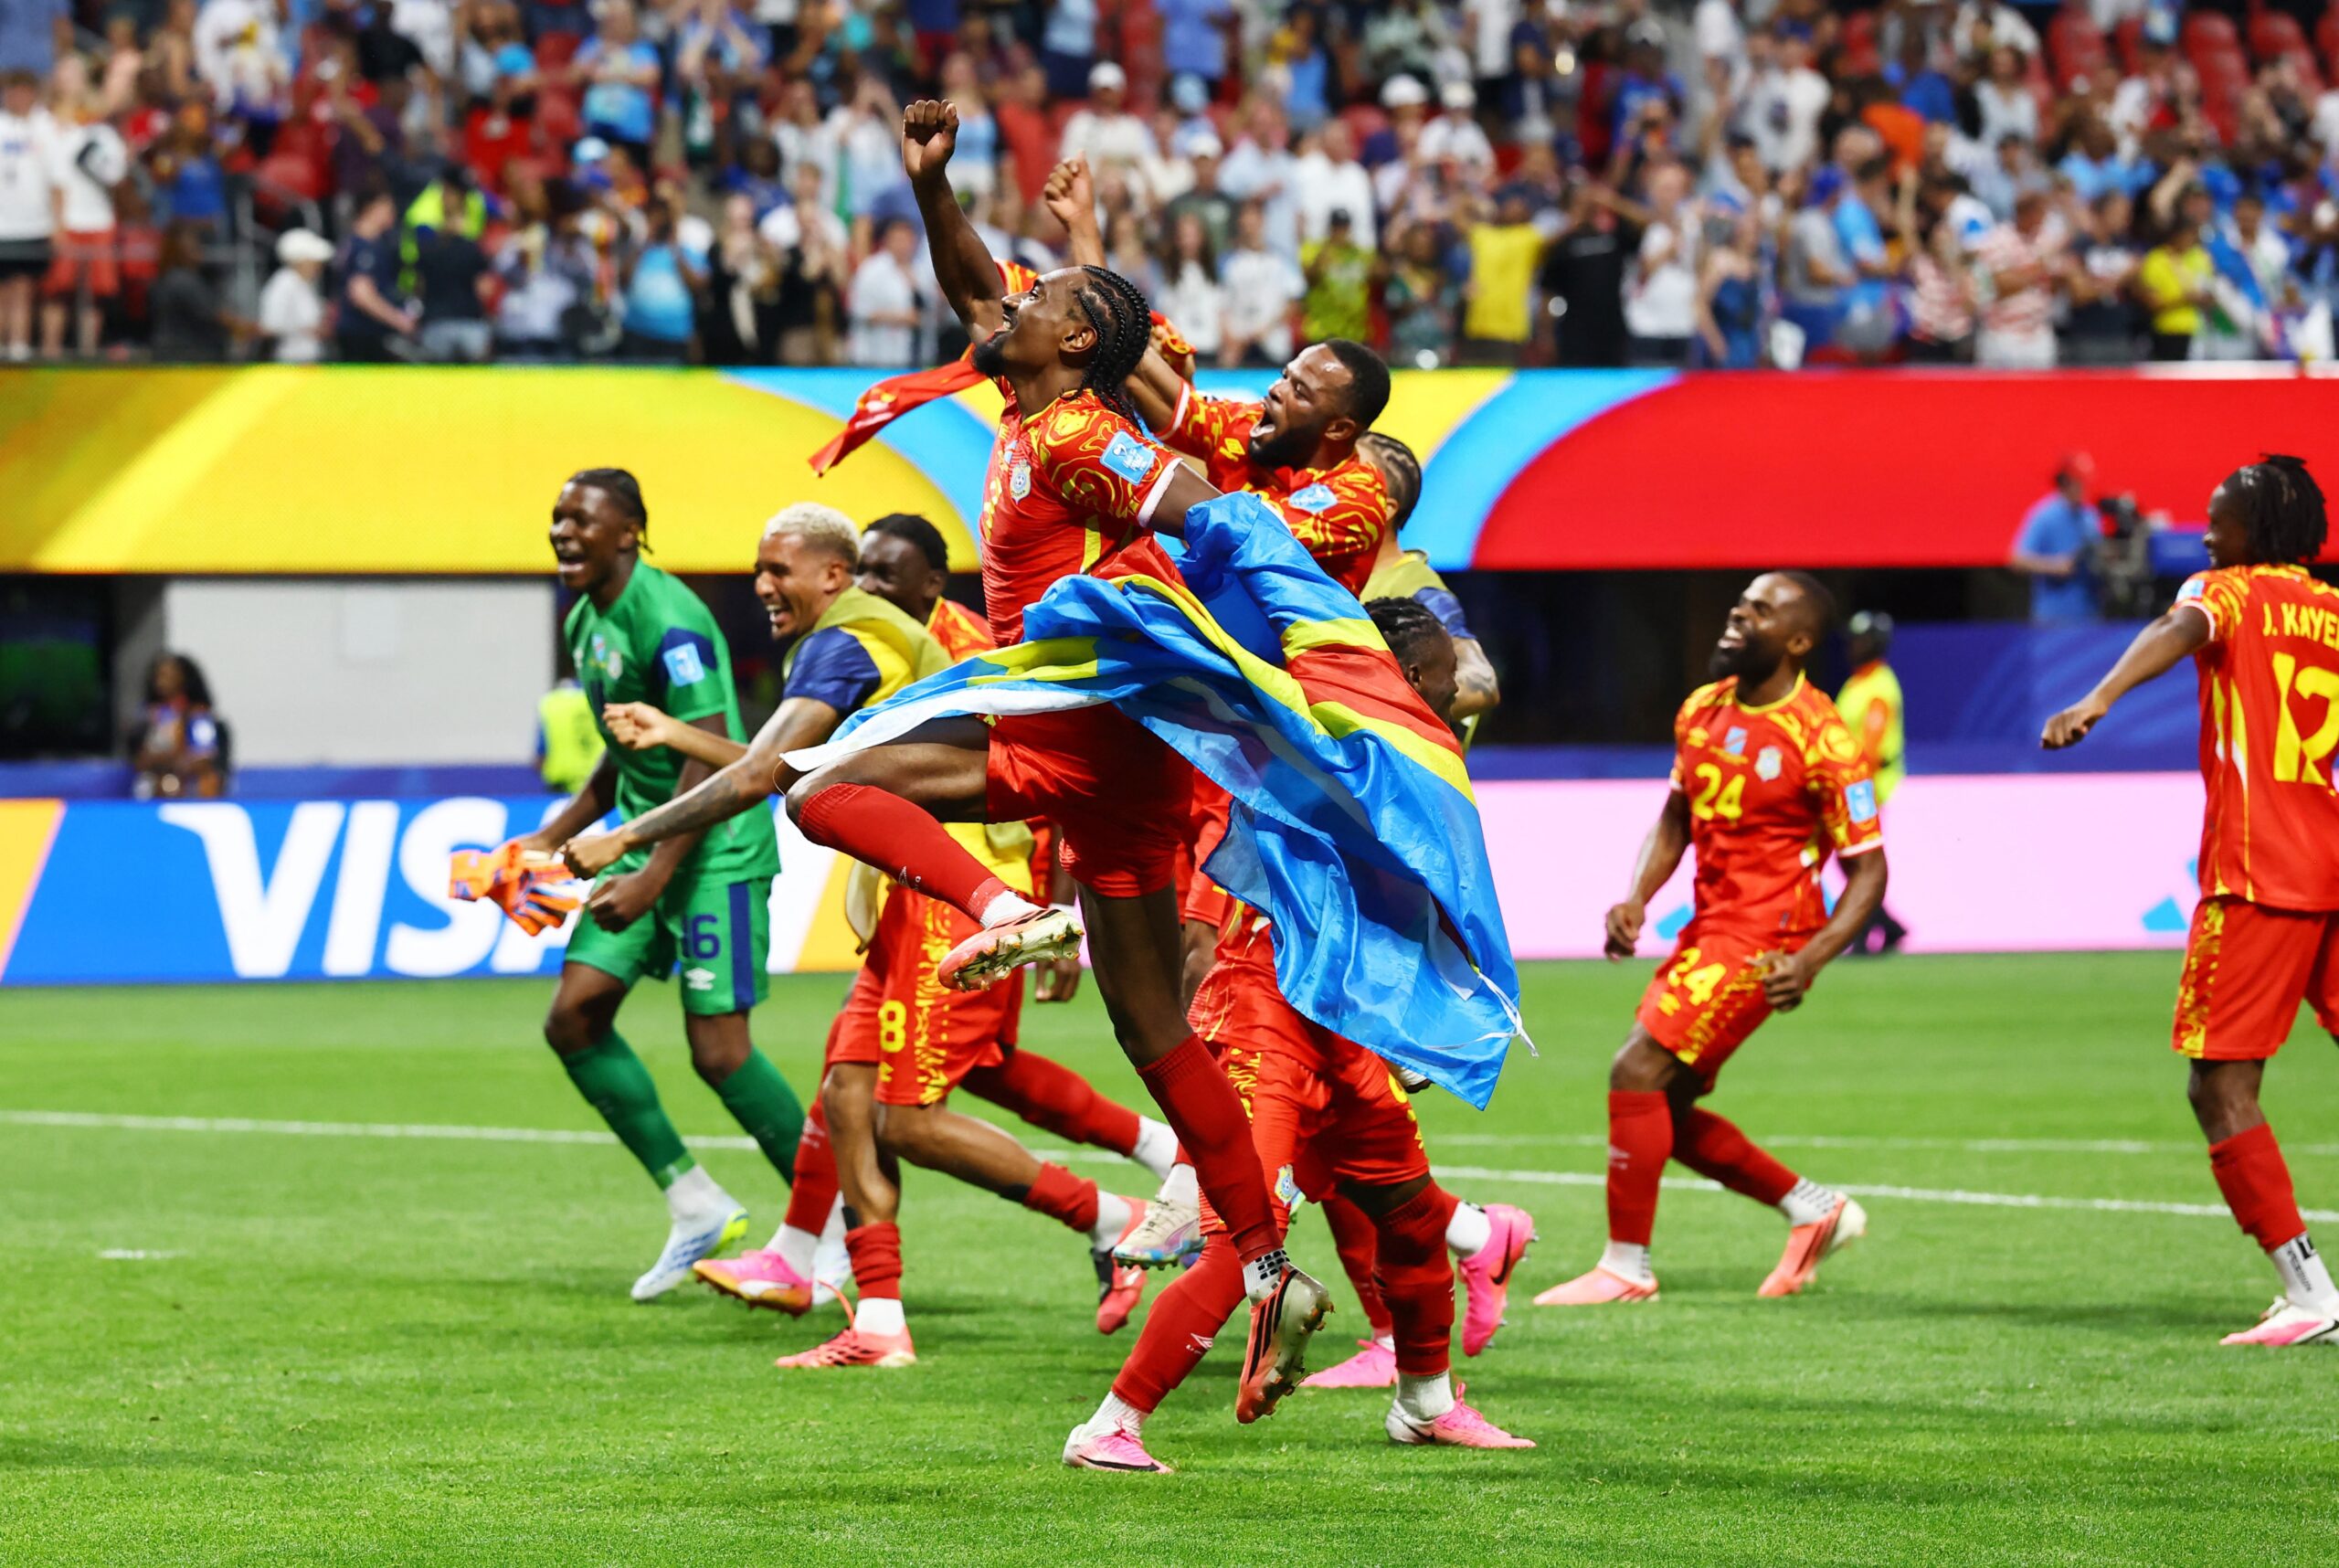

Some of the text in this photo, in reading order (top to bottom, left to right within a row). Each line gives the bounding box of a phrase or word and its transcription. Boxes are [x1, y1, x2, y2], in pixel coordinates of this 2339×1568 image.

[2262, 601, 2339, 652] J. KAYE
[2272, 651, 2339, 787] 12
[1693, 762, 1746, 821] 24
[1667, 947, 1727, 1006] 24
[878, 999, 907, 1053] 8
